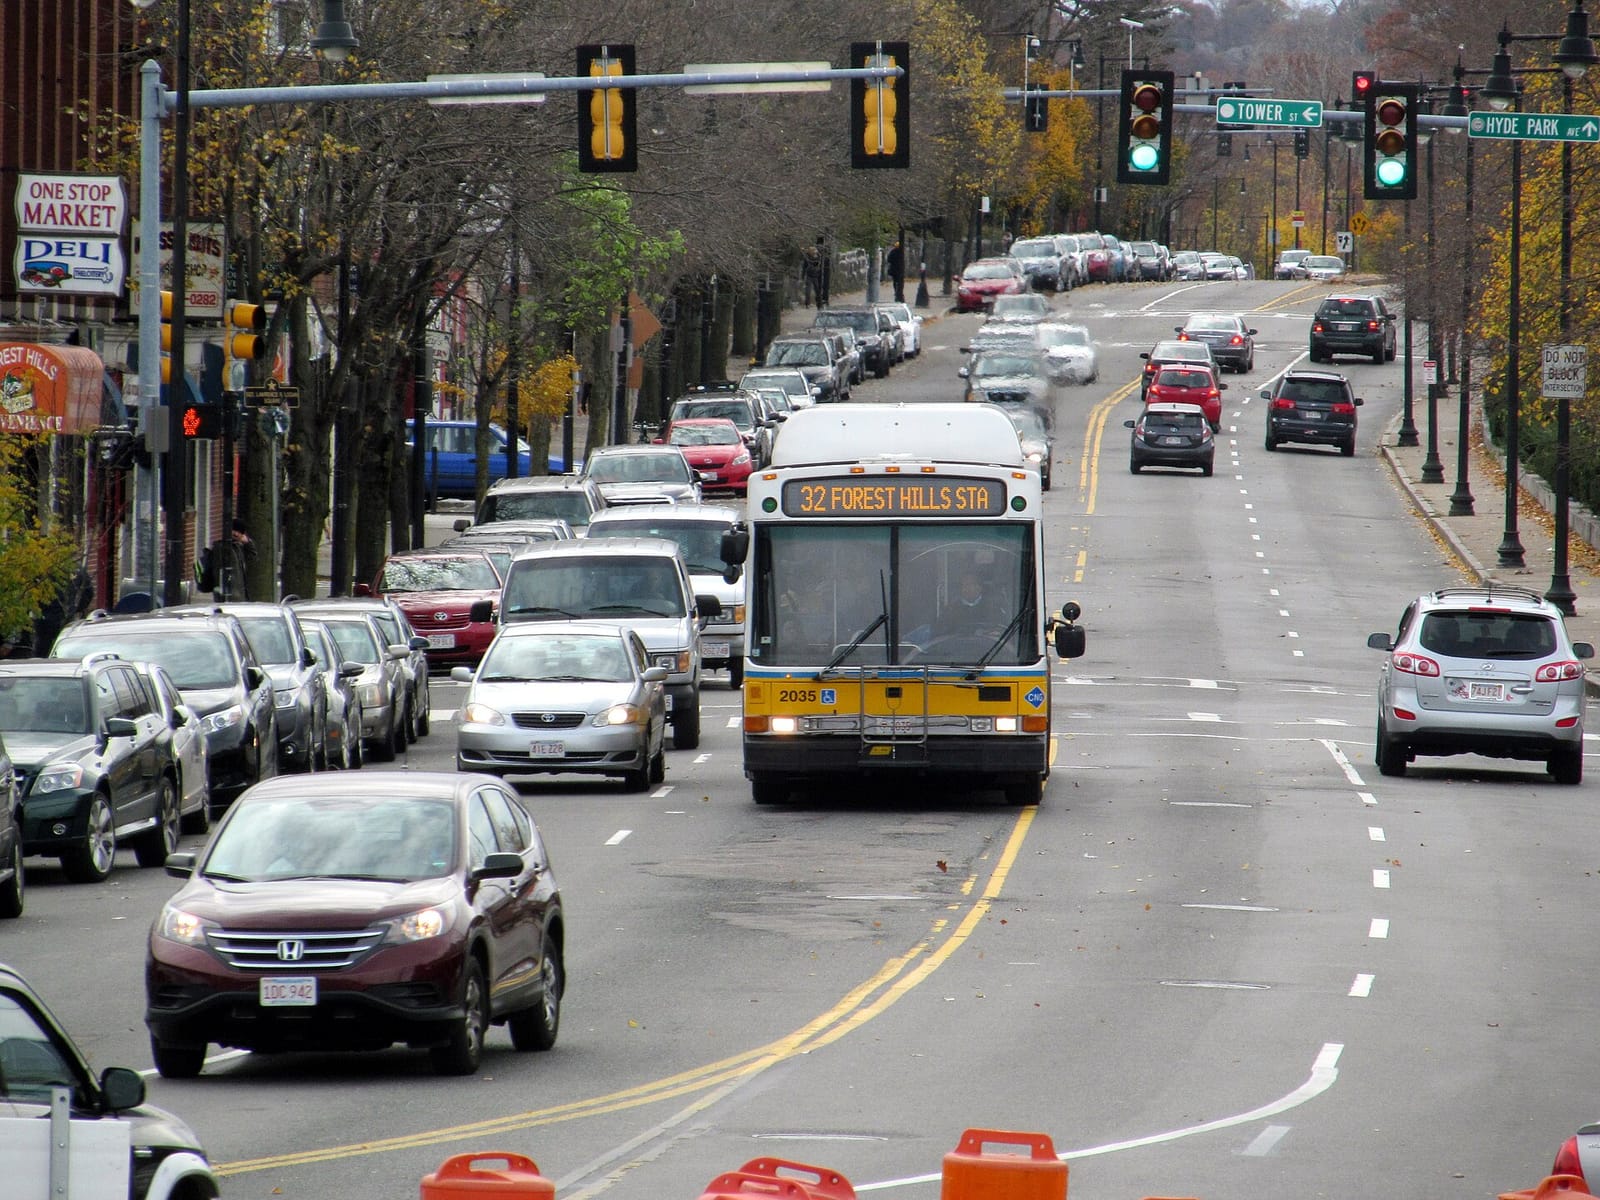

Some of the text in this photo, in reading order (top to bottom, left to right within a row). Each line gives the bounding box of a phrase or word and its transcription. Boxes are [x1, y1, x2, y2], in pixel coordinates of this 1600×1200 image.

[1238, 103, 1297, 122] TOWER ST
[1486, 117, 1581, 137] HYDE PARK AVE
[30, 182, 112, 202] ONE STOP
[23, 201, 117, 228] MARKET
[23, 239, 112, 265] DELI
[1545, 351, 1585, 364] DO NOT
[1549, 367, 1579, 380] BLOCK
[1544, 383, 1584, 393] INTERSECTION
[801, 485, 989, 512] 32 FOREST HILLS STA
[779, 690, 816, 703] 2035
[264, 985, 313, 999] 1DC 942
